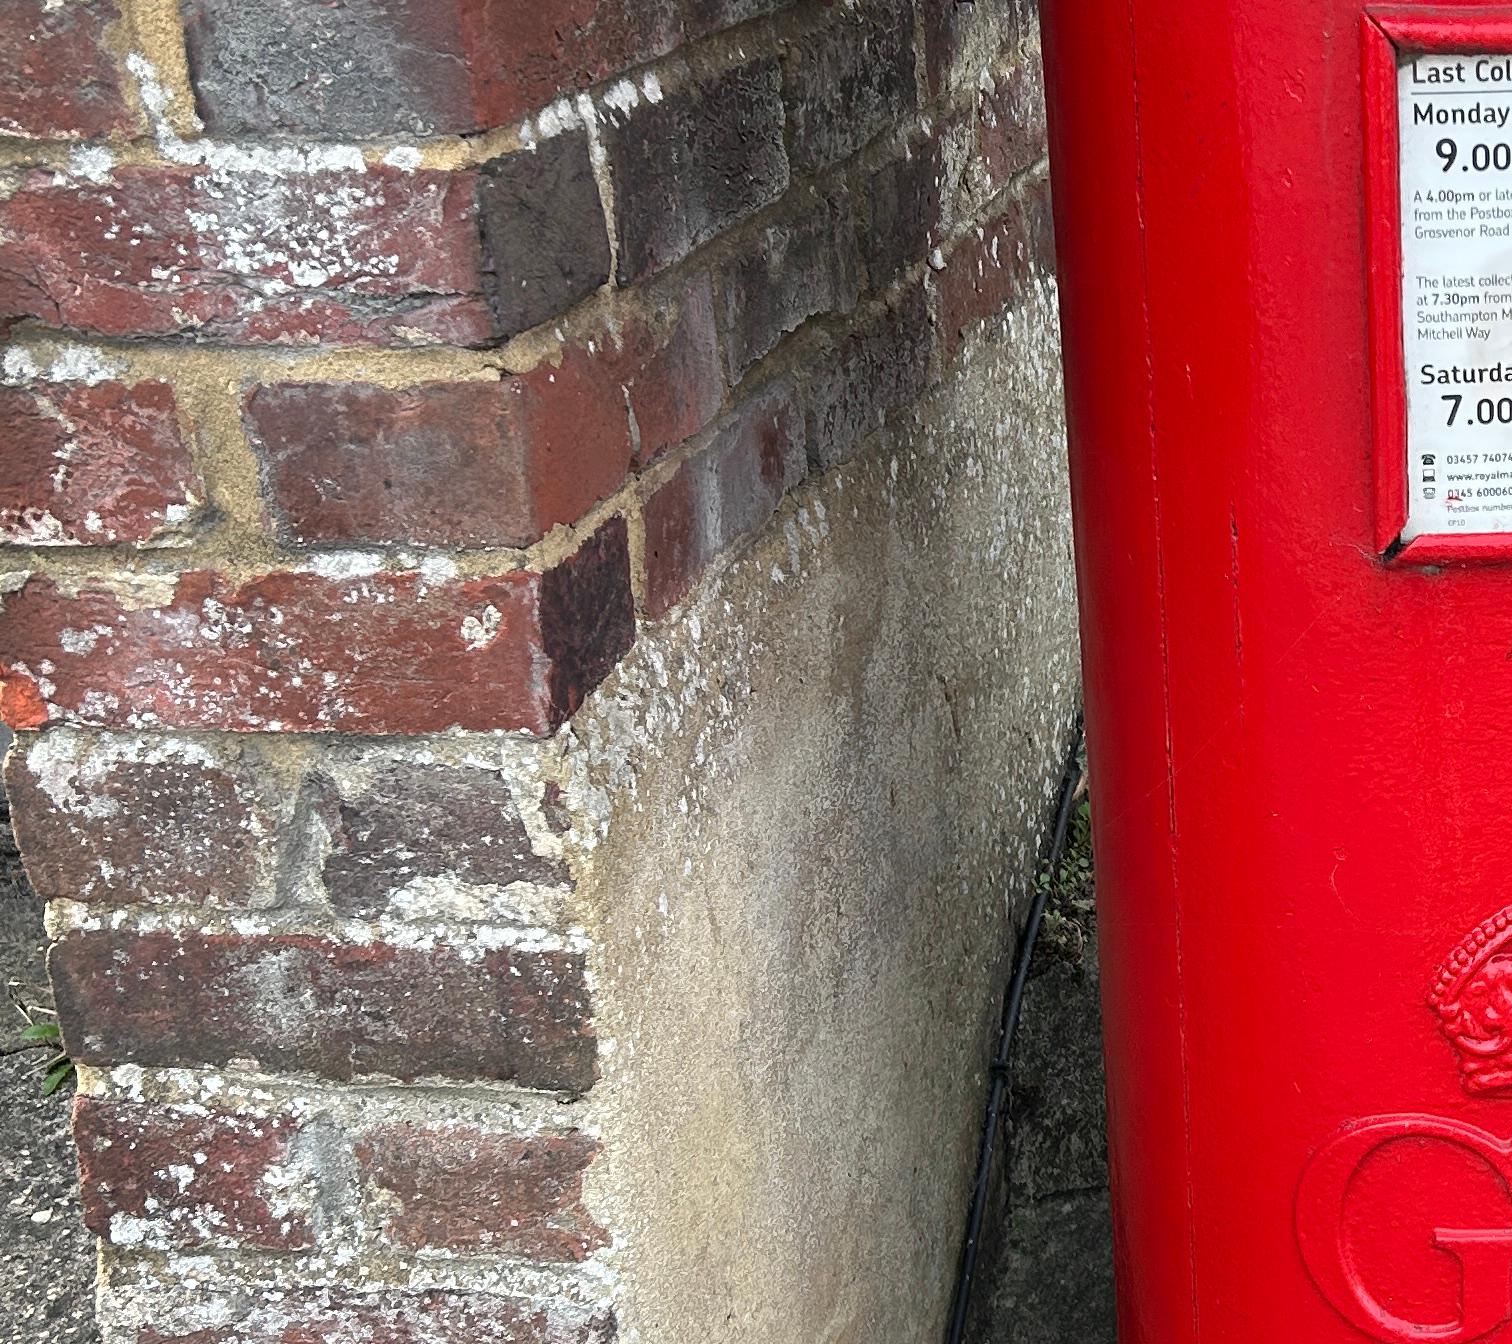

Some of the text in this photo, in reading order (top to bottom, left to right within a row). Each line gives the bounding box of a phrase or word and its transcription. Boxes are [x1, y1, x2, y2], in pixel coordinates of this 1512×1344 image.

[1412, 59, 1466, 84] Last
[1413, 102, 1510, 128] Monday
[1413, 190, 1423, 203] A
[1426, 189, 1475, 205] 4.00pm
[1479, 190, 1492, 201] or
[1414, 209, 1443, 222] from
[1447, 208, 1466, 221] the
[1414, 224, 1510, 240] Grosvenor Road
[1416, 275, 1439, 289] The
[1442, 273, 1476, 288] latest
[1416, 291, 1512, 307] at 7.30pm from
[1416, 309, 1498, 326] Southampton
[1417, 326, 1491, 342] Mitchell Way
[1446, 454, 1478, 465] 03457
